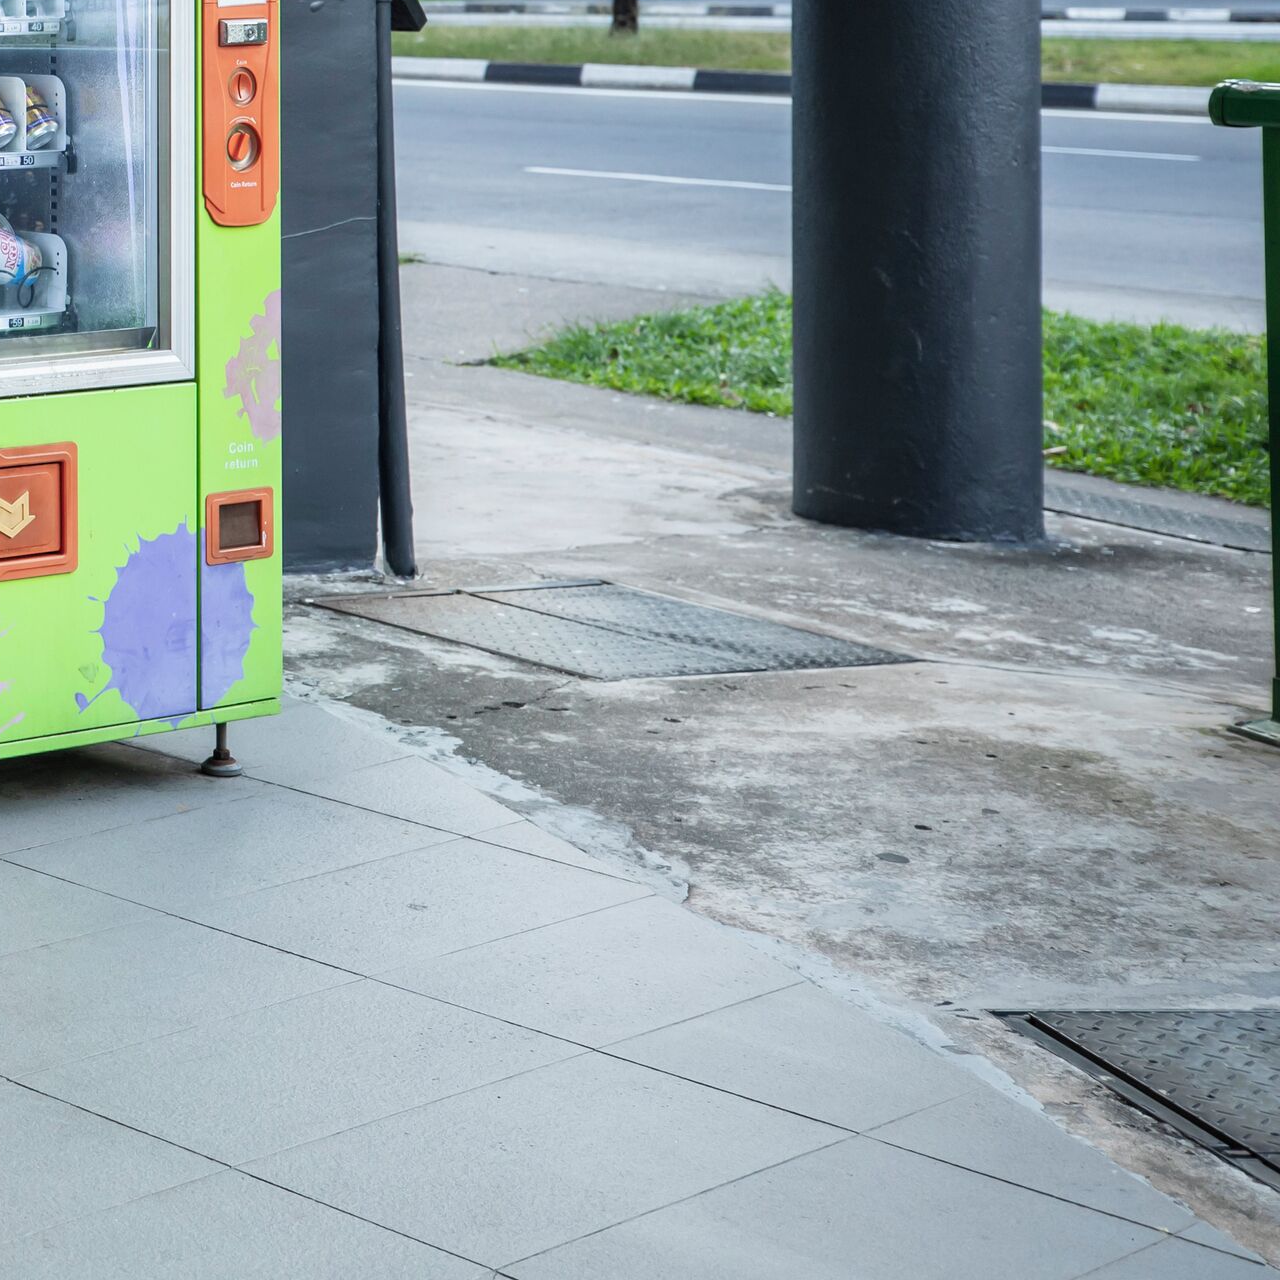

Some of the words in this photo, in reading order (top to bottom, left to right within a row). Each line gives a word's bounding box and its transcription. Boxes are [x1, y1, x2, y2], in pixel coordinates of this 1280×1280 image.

[23, 156, 34, 165] 50
[12, 318, 23, 327] 59
[228, 442, 254, 455] Coin
[225, 457, 258, 470] return
